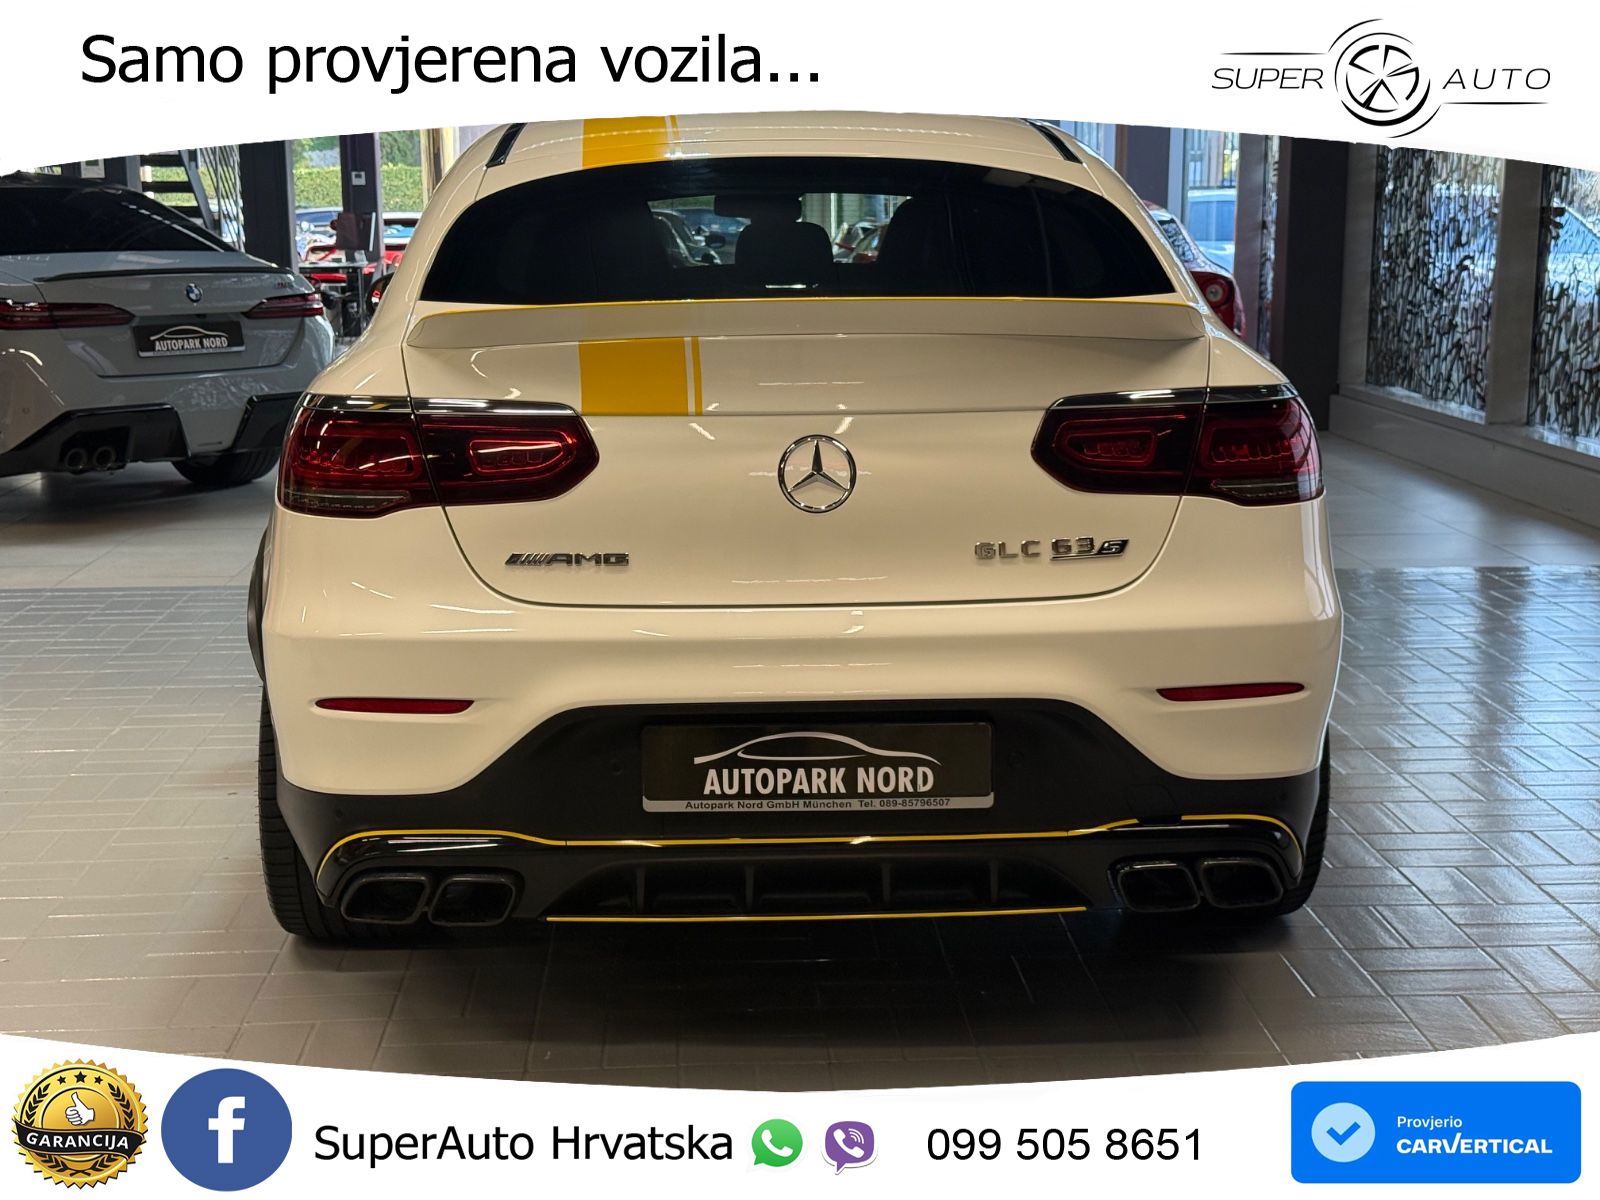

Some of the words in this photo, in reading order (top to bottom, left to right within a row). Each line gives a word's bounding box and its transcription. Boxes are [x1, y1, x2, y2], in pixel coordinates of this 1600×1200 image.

[154, 338, 201, 351] AUTOPARK
[203, 336, 228, 349] NORD
[974, 540, 1041, 560] GLC
[703, 767, 847, 795] AUTOPARK
[857, 766, 935, 794] NORD
[685, 801, 734, 810] Autopark
[737, 801, 763, 809] Nord
[766, 800, 800, 809] GmbH
[803, 799, 852, 809] München
[858, 799, 876, 808] Tel.
[879, 798, 951, 808] 089-85796507
